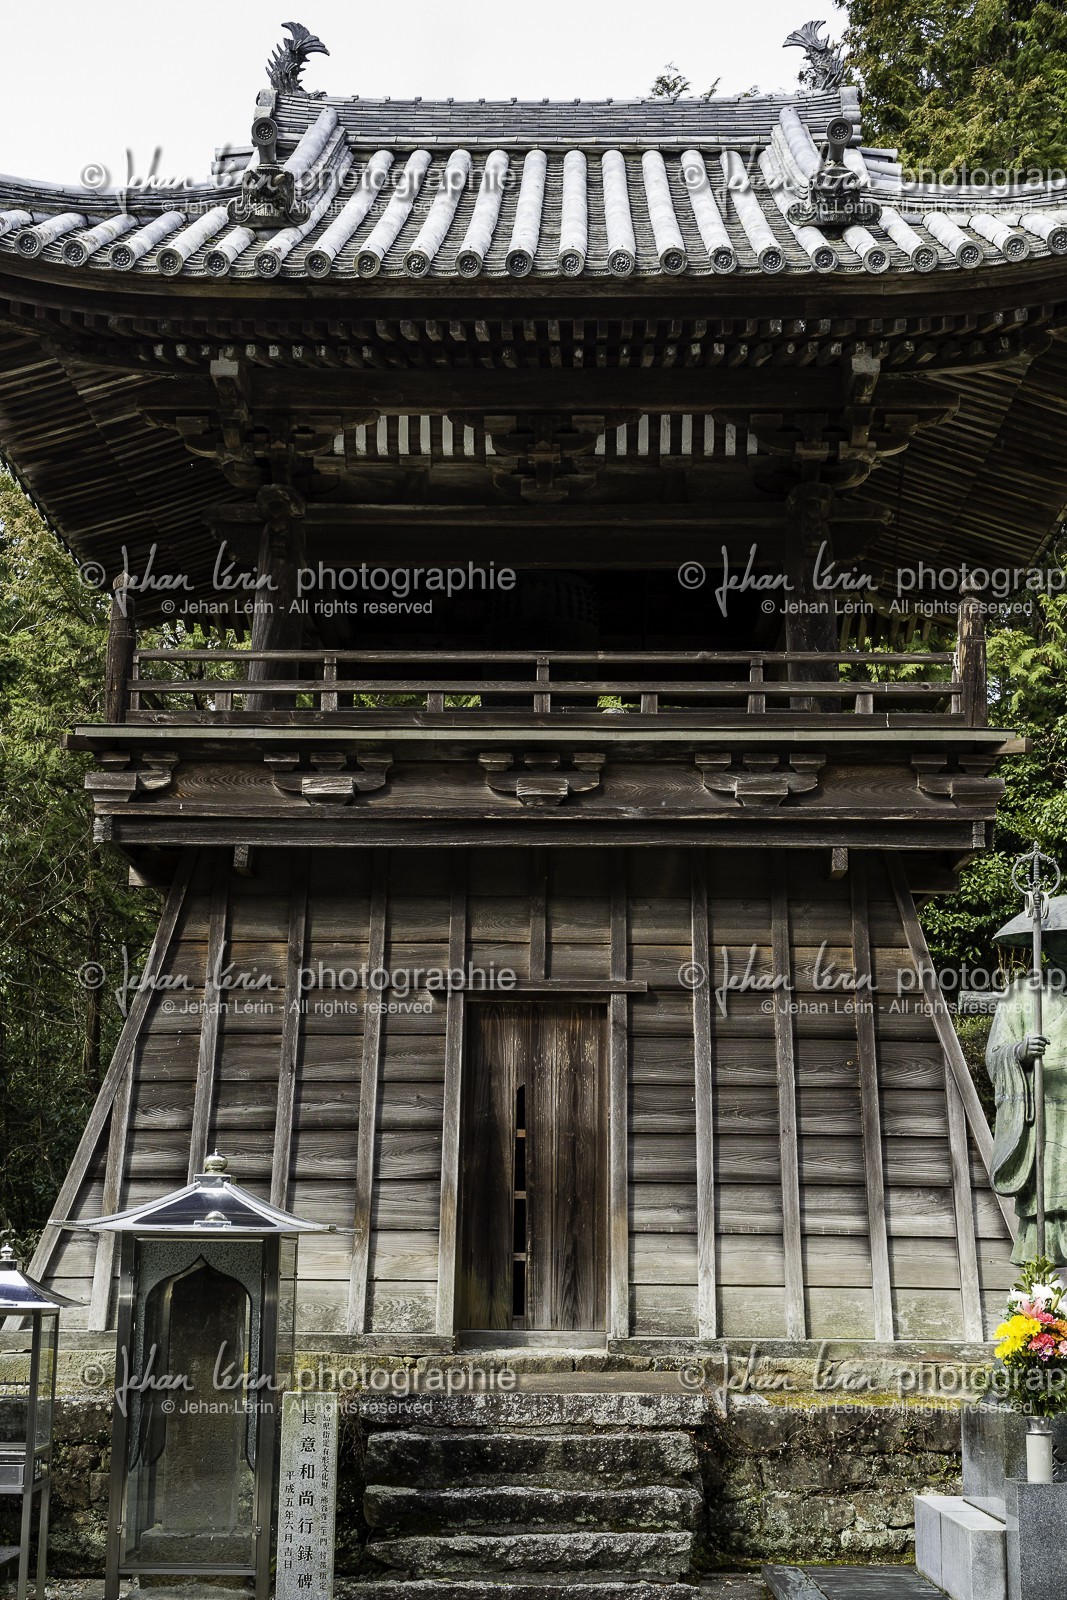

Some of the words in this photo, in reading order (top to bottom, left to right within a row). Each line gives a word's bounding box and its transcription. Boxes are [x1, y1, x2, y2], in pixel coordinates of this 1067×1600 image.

[284, 1471, 295, 1569] 平成五年六月吉日
[297, 1409, 316, 1589] 長意和尚行録碑
